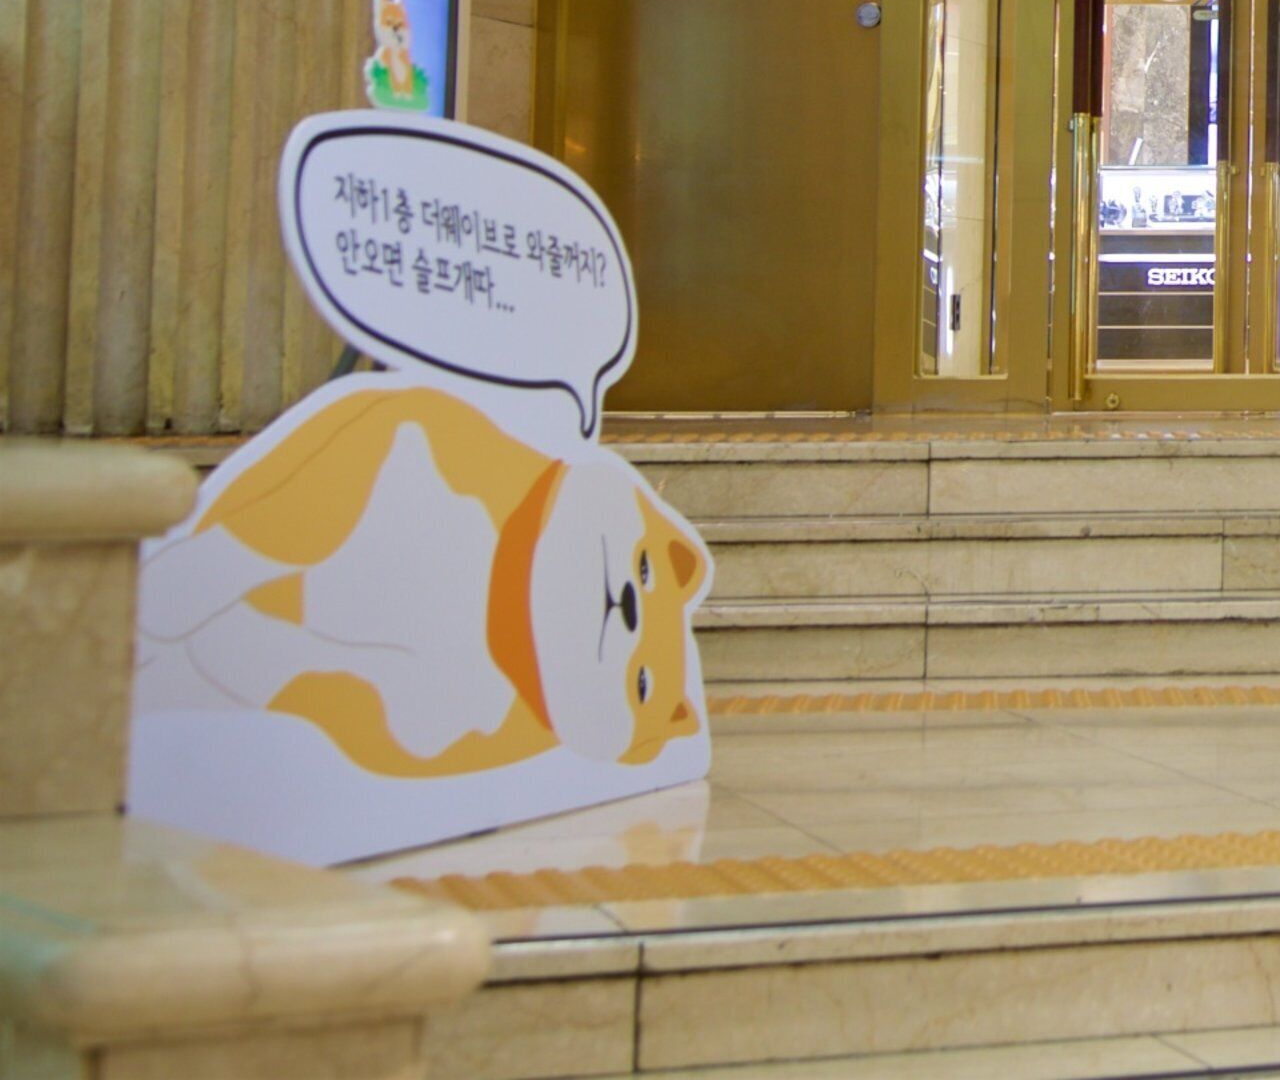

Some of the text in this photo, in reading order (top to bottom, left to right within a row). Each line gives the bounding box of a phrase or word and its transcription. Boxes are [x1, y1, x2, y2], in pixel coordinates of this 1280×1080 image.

[334, 171, 415, 236] 지하1층
[420, 197, 522, 261] 더웨이브로
[334, 228, 405, 288] 안오면
